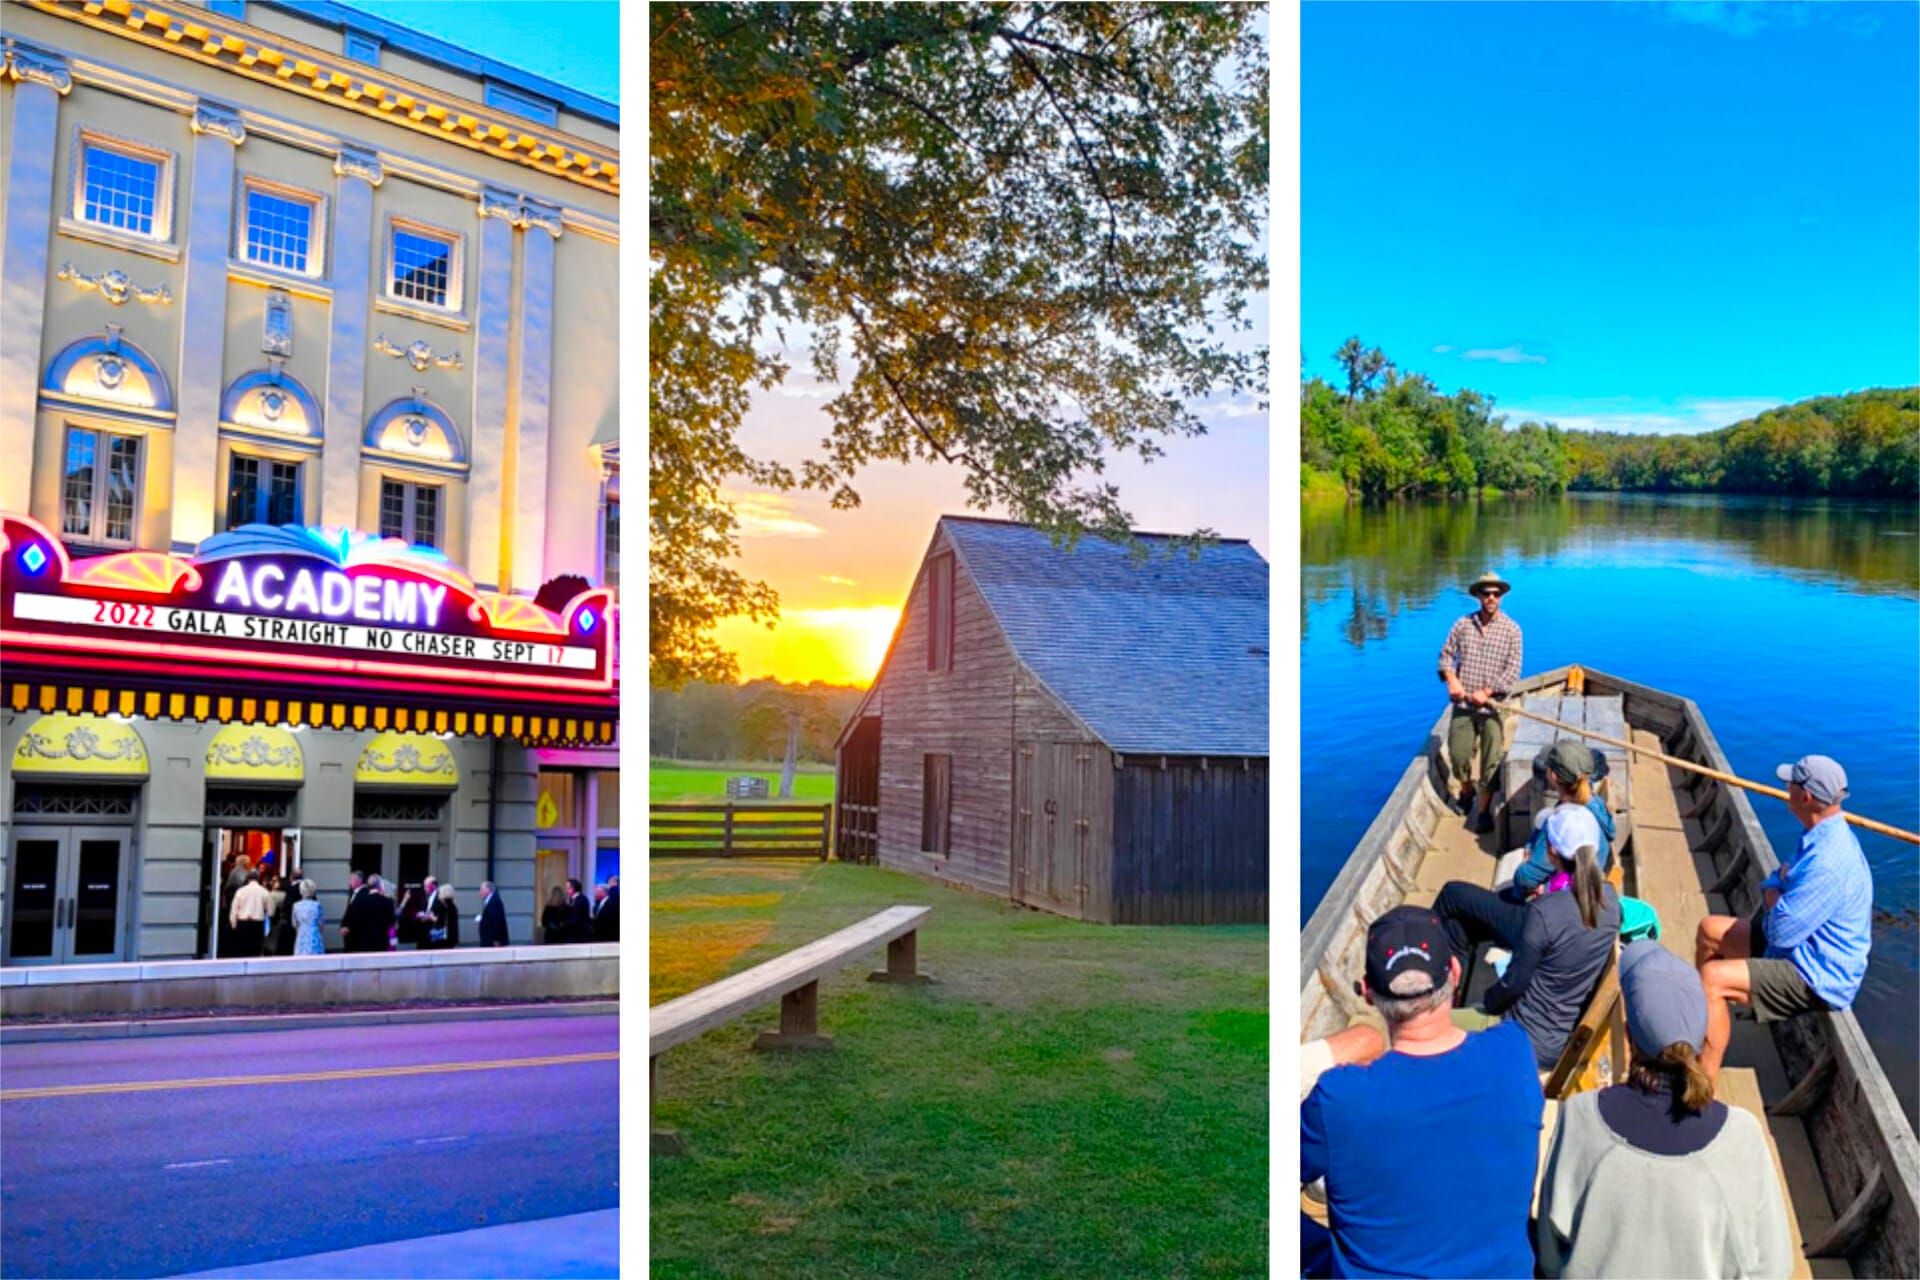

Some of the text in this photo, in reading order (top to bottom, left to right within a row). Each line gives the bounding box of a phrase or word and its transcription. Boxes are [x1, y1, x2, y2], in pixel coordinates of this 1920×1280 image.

[215, 560, 448, 627] ACADEMY
[94, 600, 565, 665] 2022 GALA STRAIGHT NO CHASER SEPT 17
